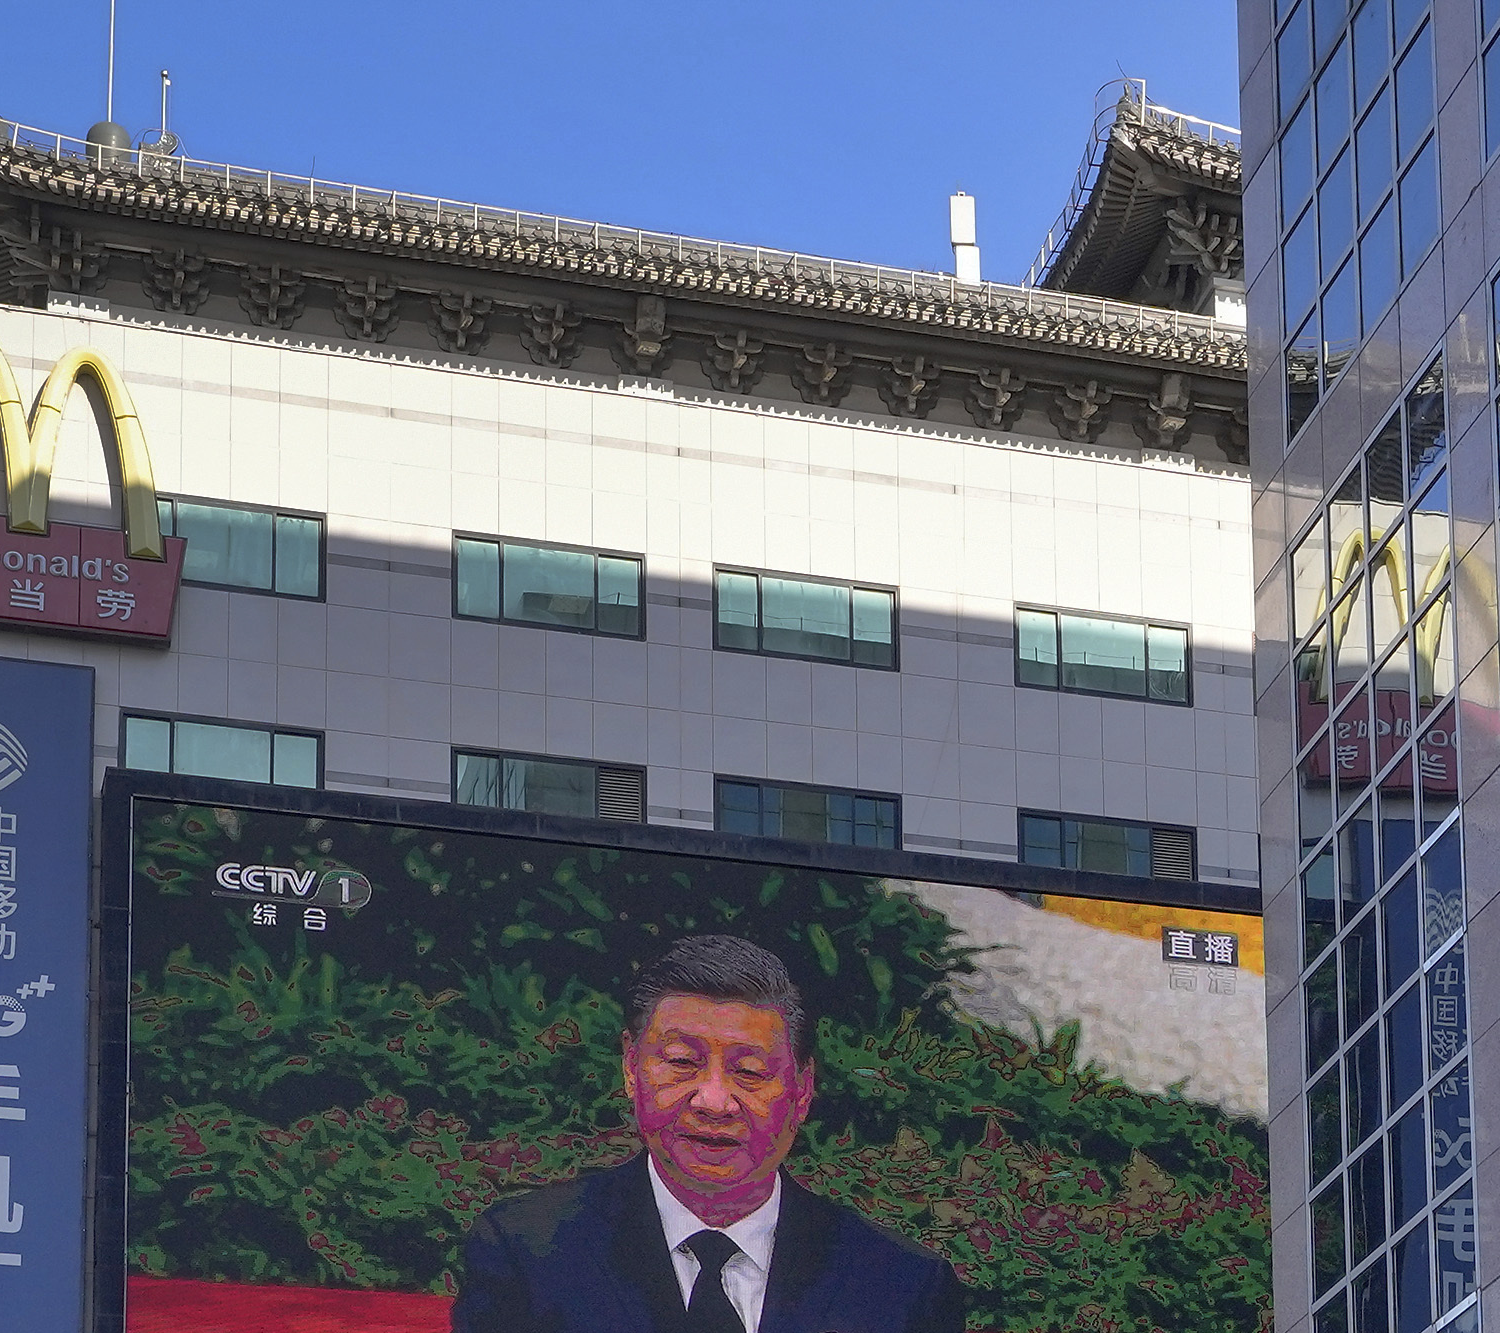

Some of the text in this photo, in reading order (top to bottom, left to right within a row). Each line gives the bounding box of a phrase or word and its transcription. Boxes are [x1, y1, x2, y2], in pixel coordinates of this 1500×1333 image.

[216, 862, 316, 896] CCTV
[253, 903, 327, 931] 综合
[1168, 930, 1233, 964] 直播
